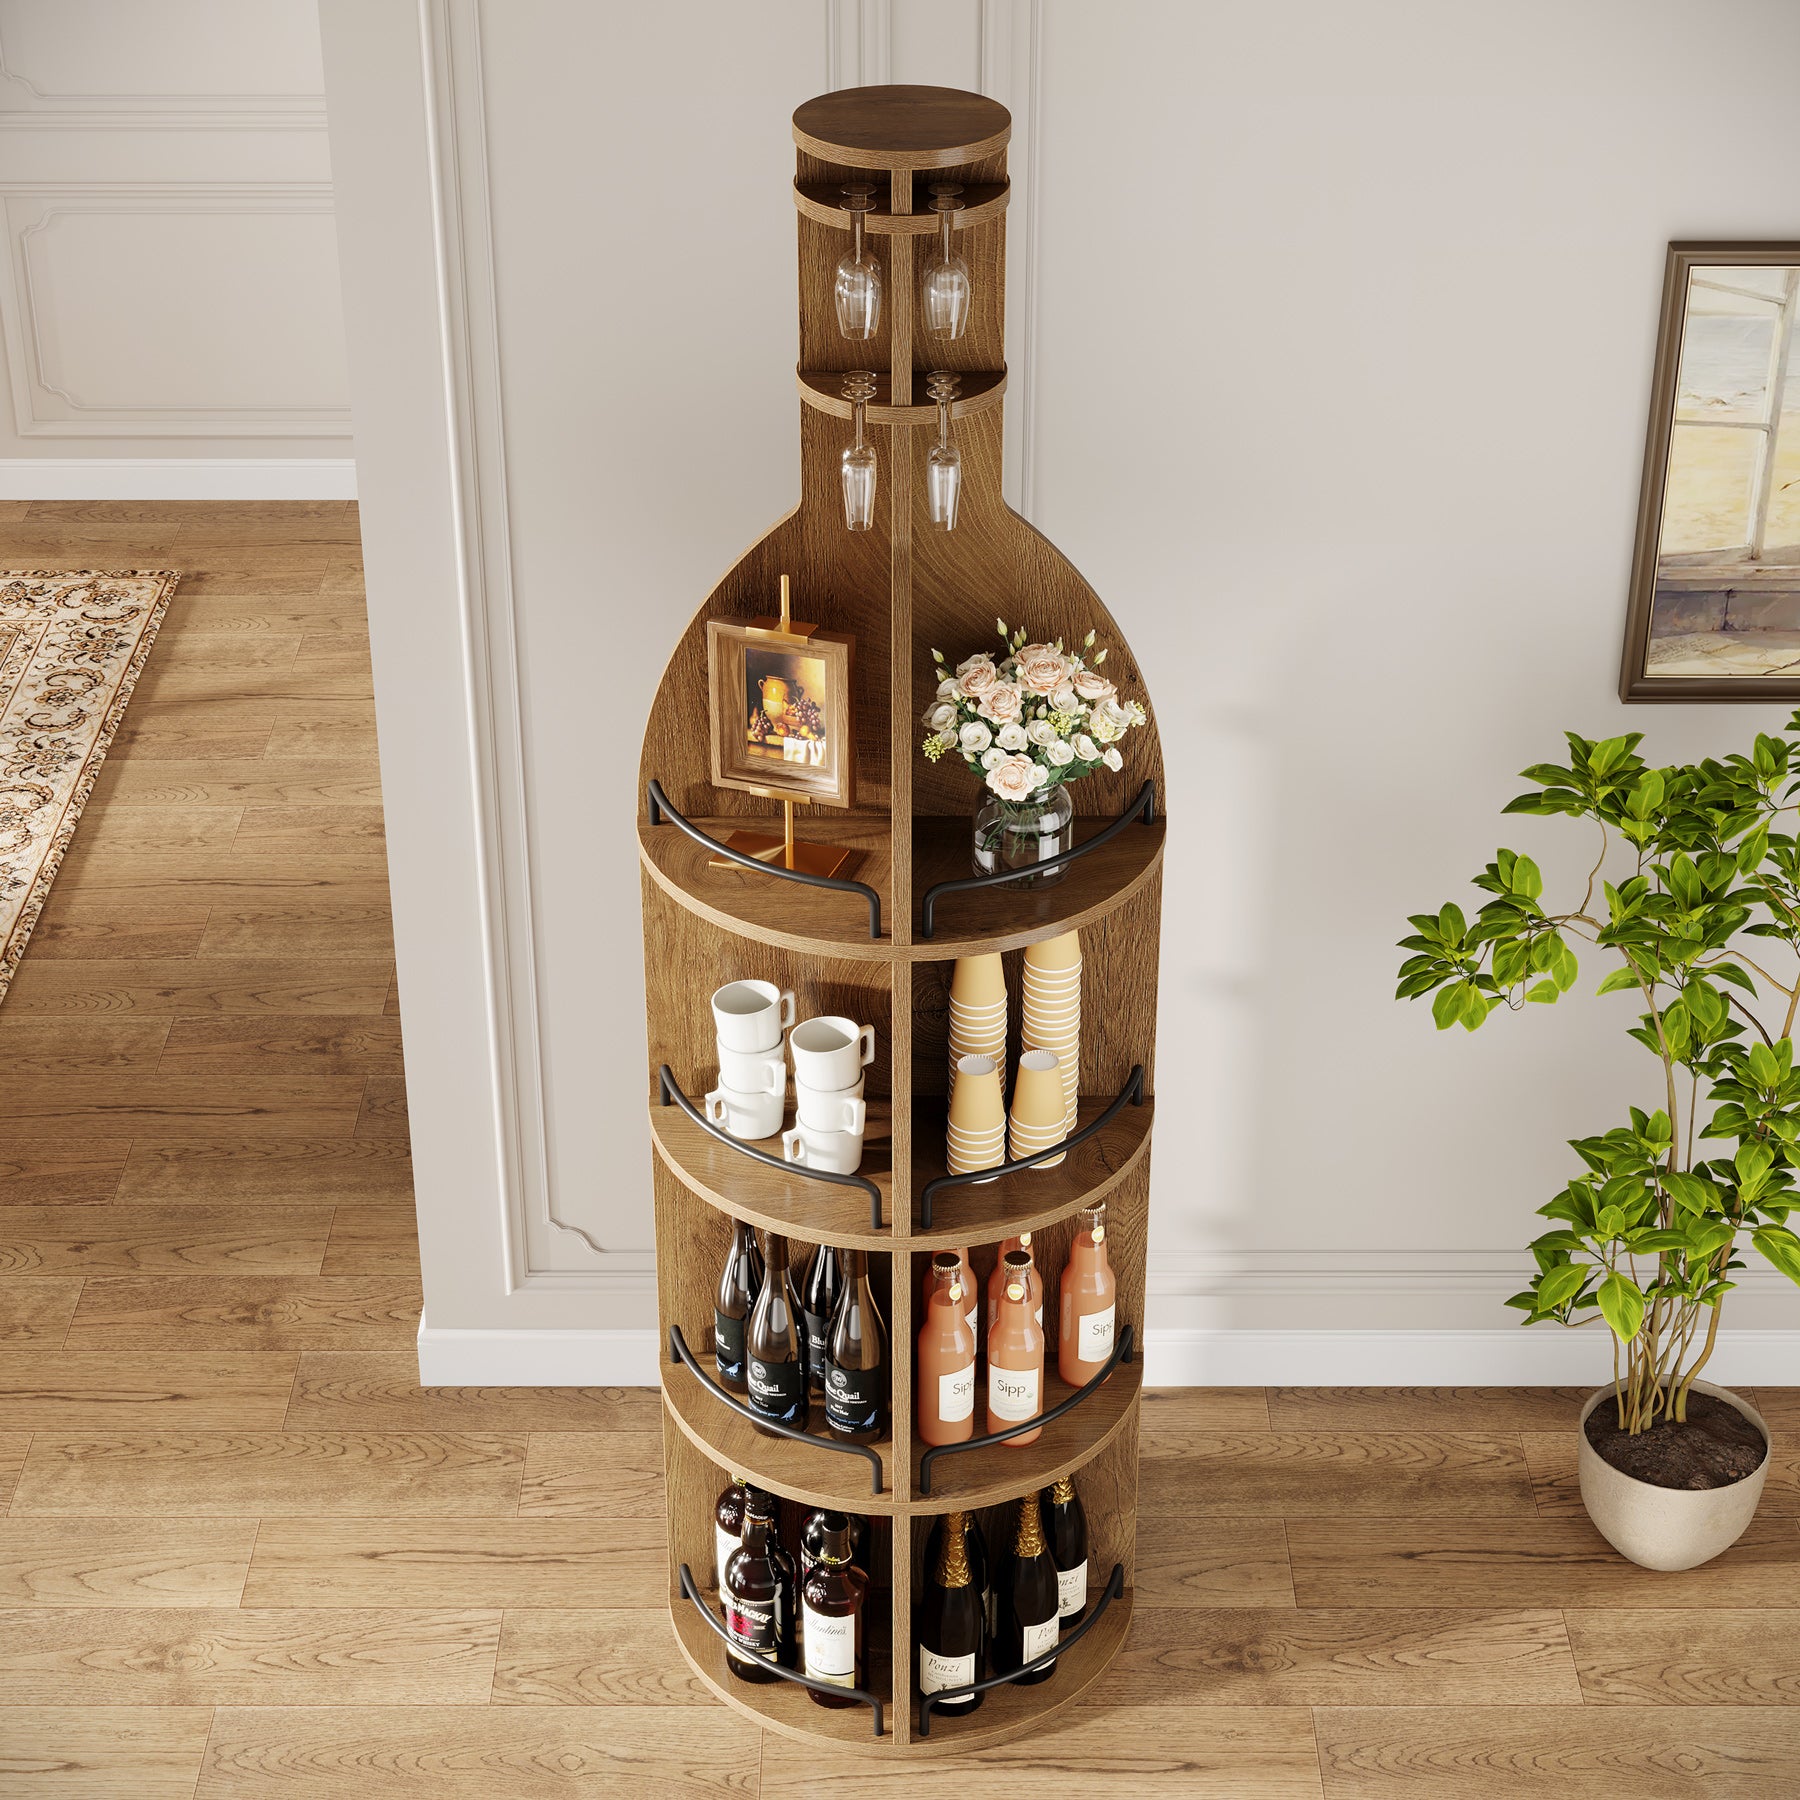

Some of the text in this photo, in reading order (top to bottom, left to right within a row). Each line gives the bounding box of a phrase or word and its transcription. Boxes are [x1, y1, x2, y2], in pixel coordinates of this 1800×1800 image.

[811, 1334, 825, 1346] Blu
[757, 1381, 780, 1393] Quail
[997, 1379, 1026, 1398] Sipp
[837, 1388, 860, 1401] Quail
[928, 1658, 961, 1673] Ponzi
